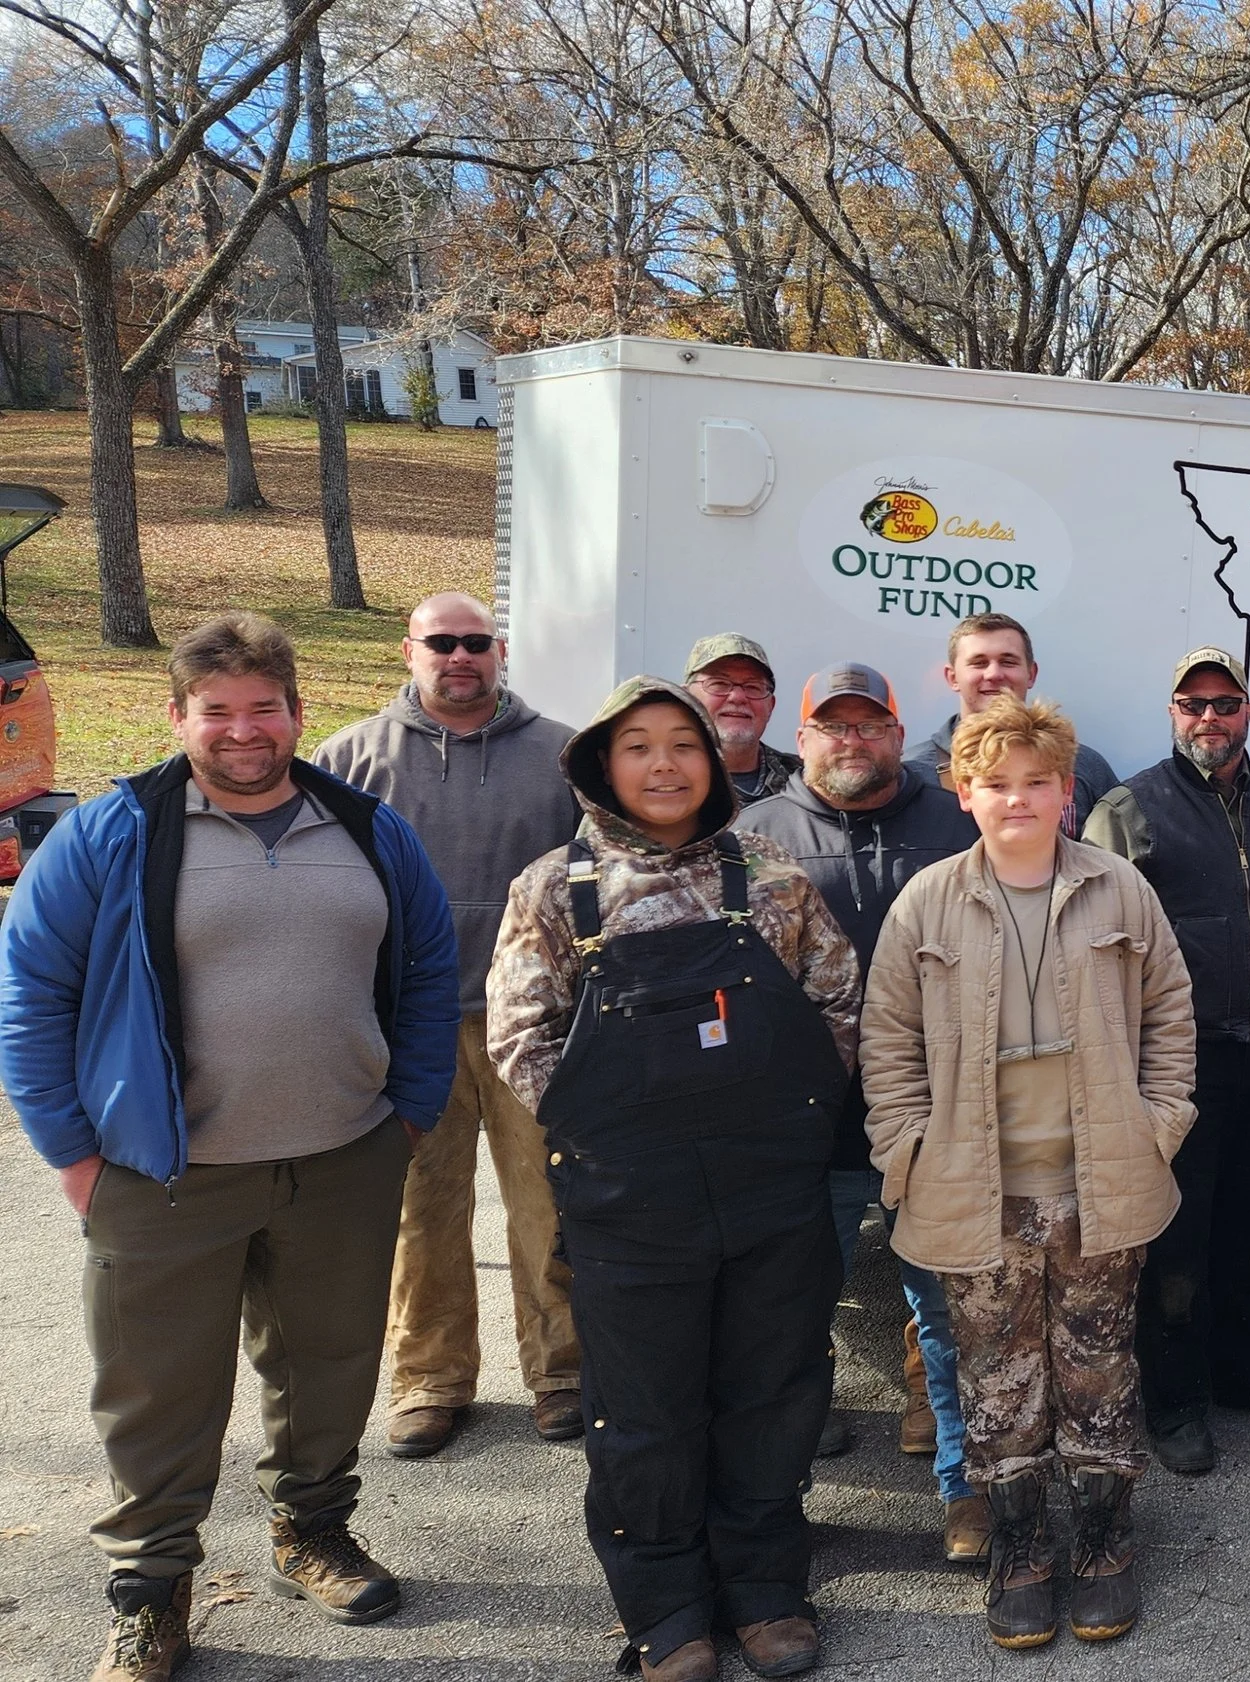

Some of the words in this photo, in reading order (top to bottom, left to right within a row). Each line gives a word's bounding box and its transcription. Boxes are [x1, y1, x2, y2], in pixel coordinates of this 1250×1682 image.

[892, 494, 921, 511] Bass
[892, 508, 915, 523] Pro
[891, 520, 928, 538] Shops
[943, 515, 1015, 541] Cabela's
[831, 544, 1039, 591] OUTDOOR
[878, 586, 992, 619] FUND
